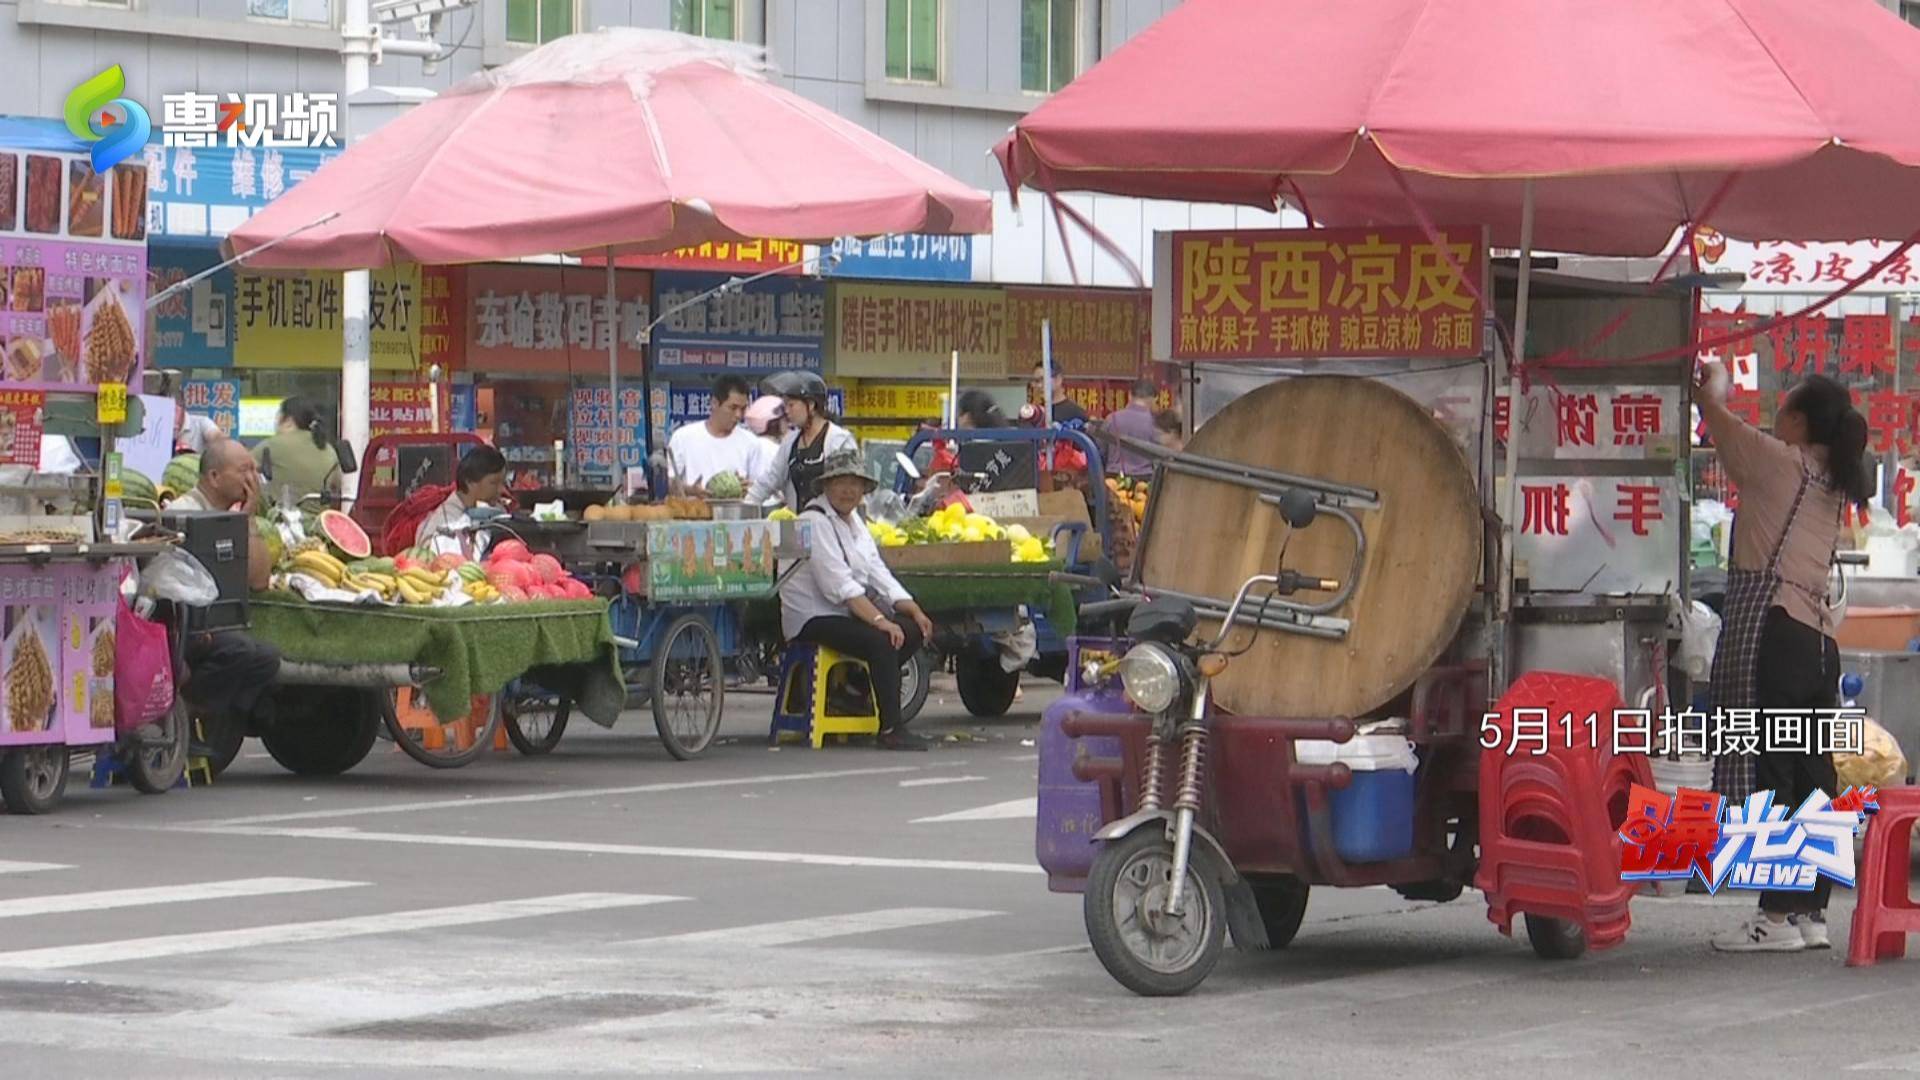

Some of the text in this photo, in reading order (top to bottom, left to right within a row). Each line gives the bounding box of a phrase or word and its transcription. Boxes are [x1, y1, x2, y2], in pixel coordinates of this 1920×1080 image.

[1182, 233, 1477, 315] 陕西凉皮
[1179, 314, 1260, 352] 煎饼果子
[1269, 314, 1329, 351] 手抓饼
[1339, 313, 1421, 350] 豌豆凉粉
[1431, 312, 1473, 349] 凉面
[184, 383, 236, 407] 批发
